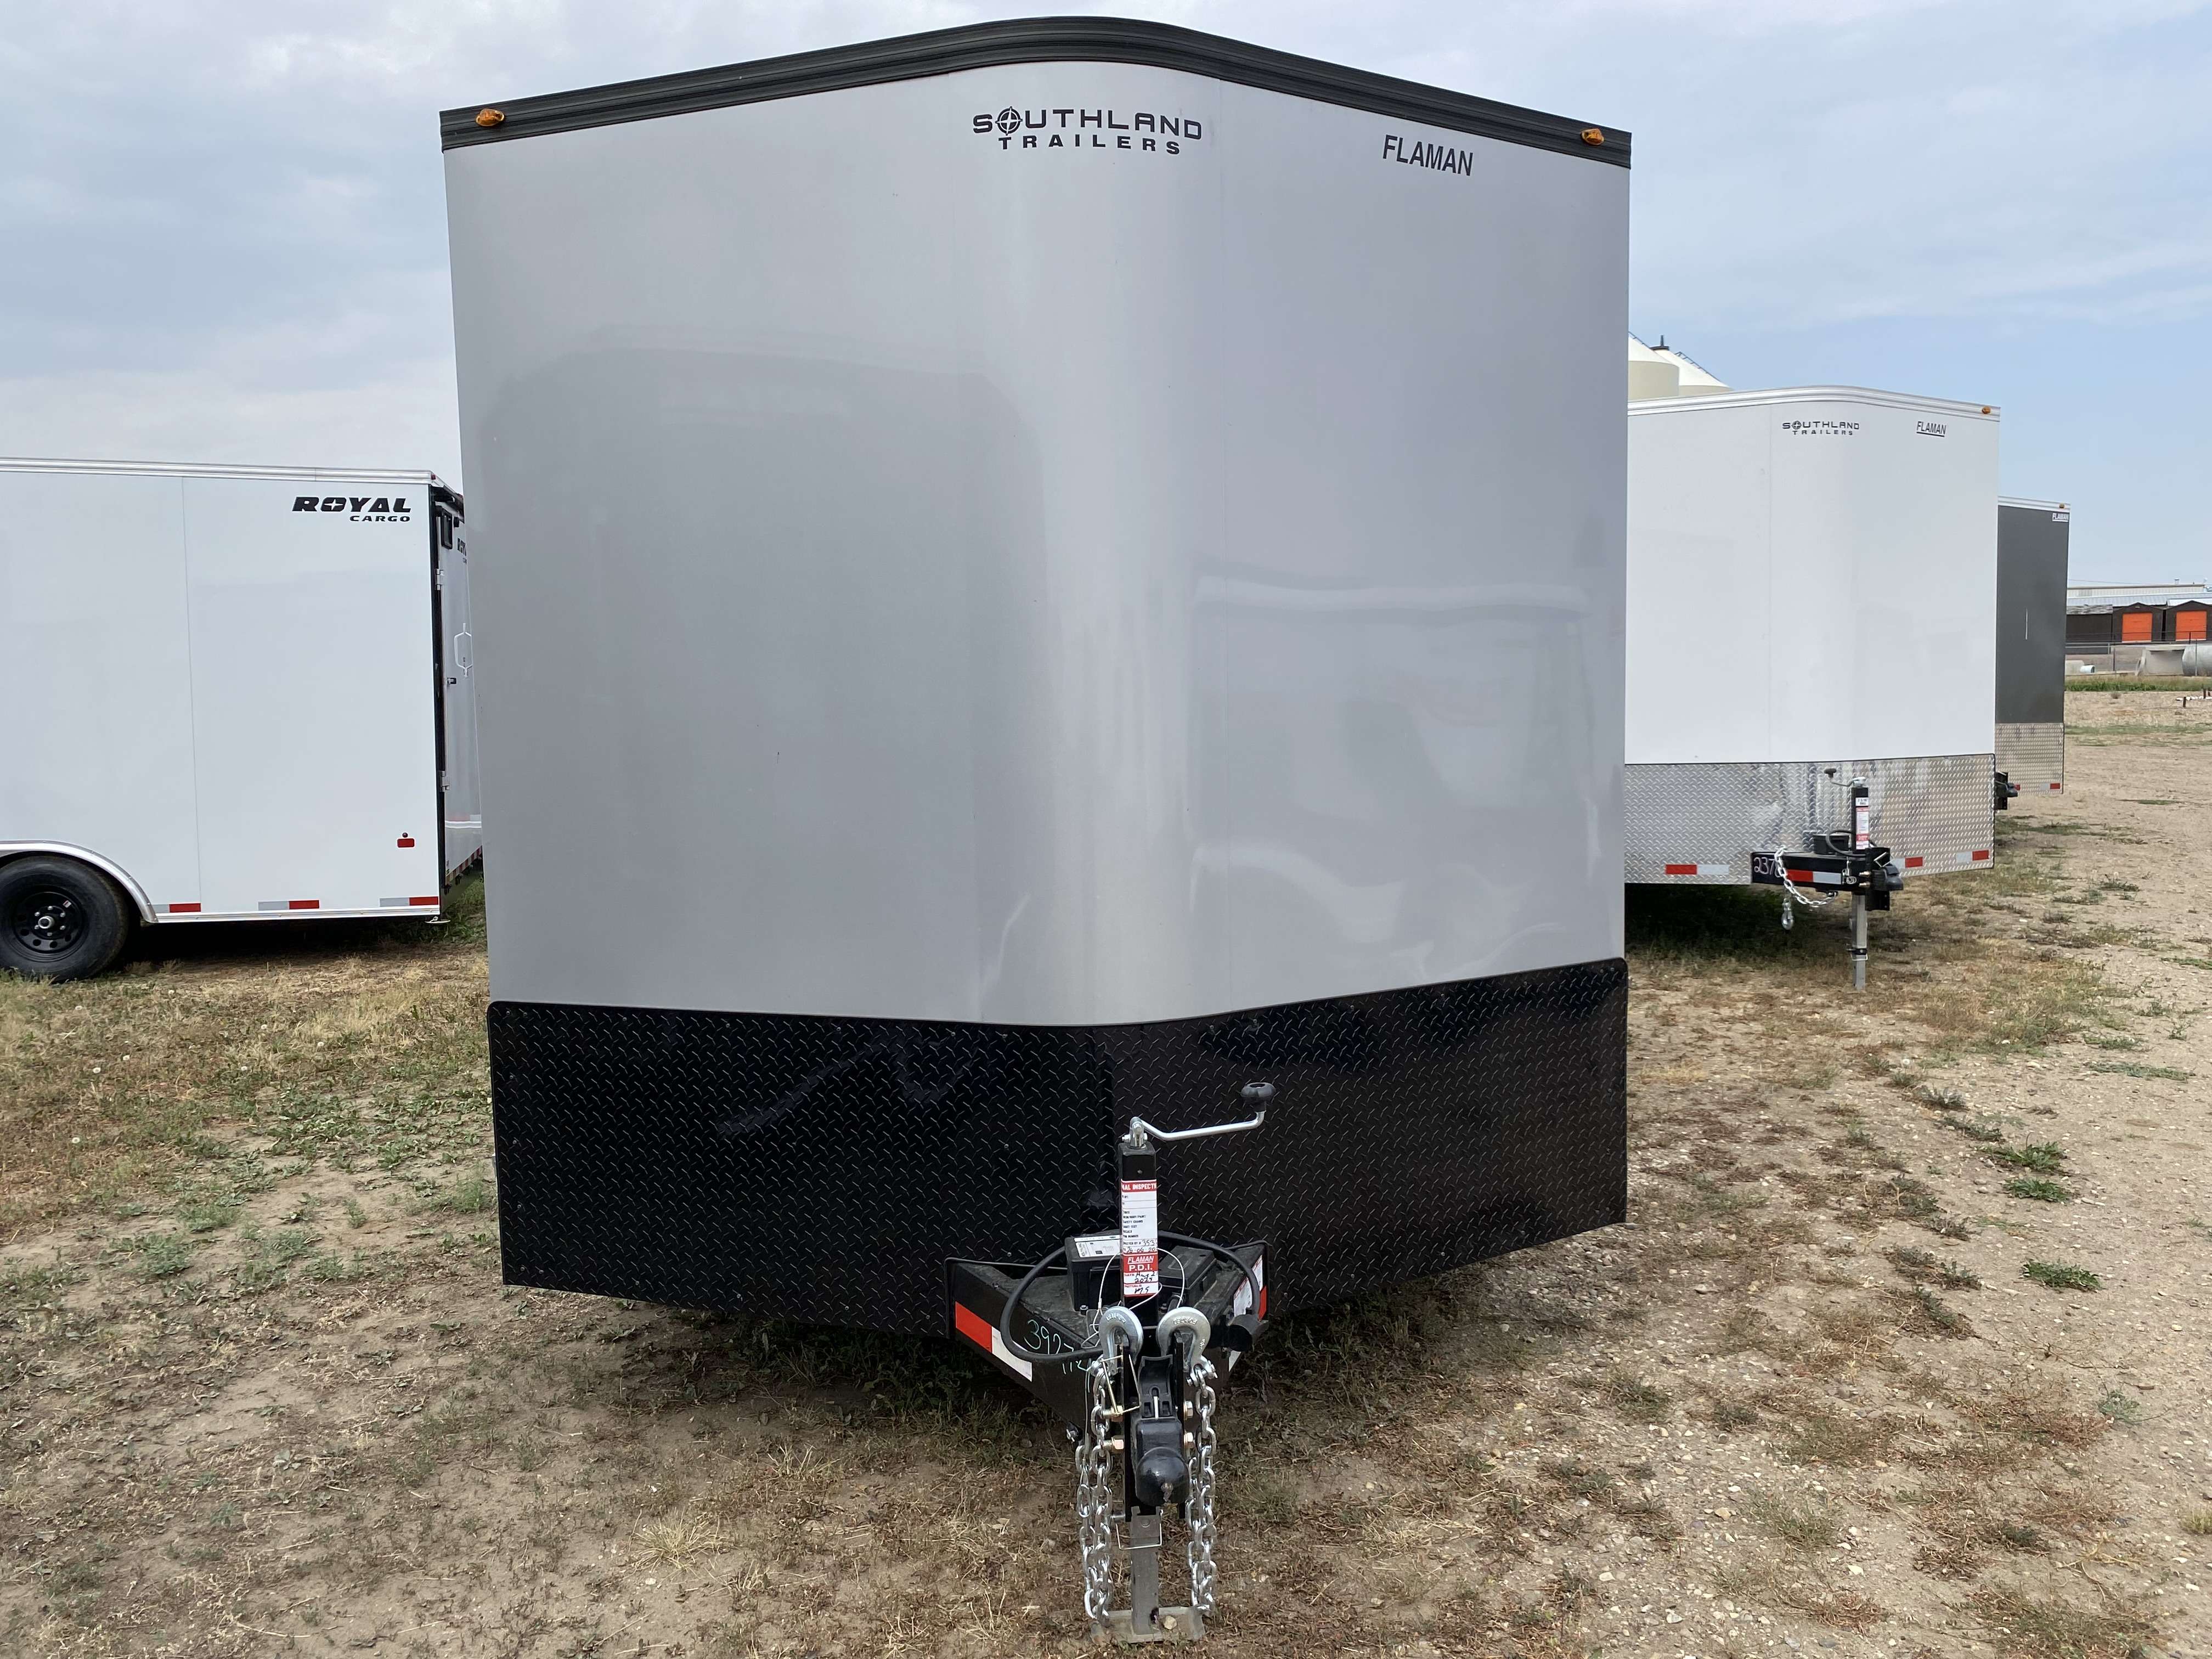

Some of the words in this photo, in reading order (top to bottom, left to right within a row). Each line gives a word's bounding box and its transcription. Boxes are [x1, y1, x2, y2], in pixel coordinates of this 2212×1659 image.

[973, 106, 1202, 140] SOUTHLAND
[998, 134, 1180, 155] TRAILERS
[1383, 134, 1474, 177] FLAMAN
[1782, 421, 1860, 430] SOUTHLAND
[1916, 421, 1947, 435] FLAMAN
[291, 496, 411, 513] ROYAL
[1127, 1255, 1154, 1263] FLAMAN
[1128, 1263, 1153, 1272] P.D.I.
